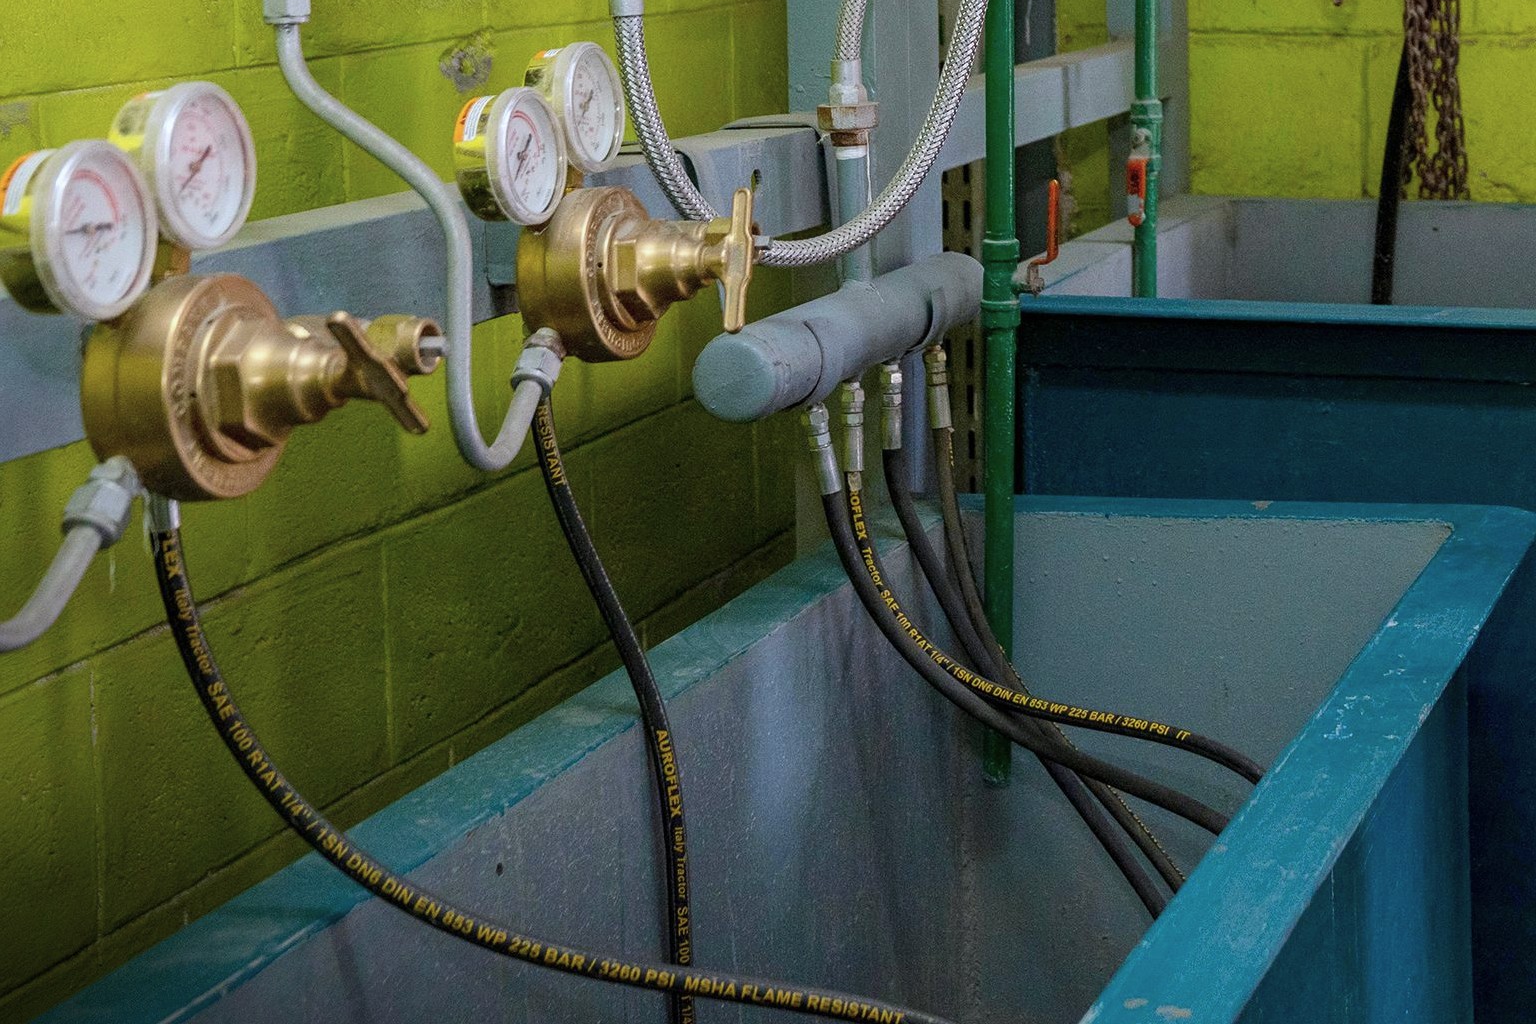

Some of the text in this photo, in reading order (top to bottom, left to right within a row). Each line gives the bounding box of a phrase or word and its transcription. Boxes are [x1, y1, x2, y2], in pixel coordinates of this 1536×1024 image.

[538, 405, 567, 486] RESISTANT
[862, 547, 884, 586] Tractor
[881, 589, 899, 612] SAE
[908, 628, 932, 652] R1AT
[953, 666, 973, 683] 1SN
[971, 678, 994, 692] DN6
[993, 687, 1013, 701] DIN
[1012, 693, 1030, 706] EN
[1029, 698, 1049, 710] 853
[1050, 702, 1068, 714] WP
[1068, 707, 1088, 718] 225
[1089, 711, 1114, 724] BAR
[1121, 716, 1148, 730] 3260
[1149, 722, 1170, 736] PSI
[1176, 729, 1191, 741] IT
[162, 532, 182, 579] LEX
[174, 589, 192, 621] Italy
[185, 625, 214, 675] Tractor
[207, 681, 236, 721] SAE
[229, 720, 253, 751] 100
[248, 750, 285, 791] R1AT
[316, 827, 350, 859] 1SN
[345, 852, 383, 885] DN6
[381, 877, 414, 905] DIN
[413, 895, 442, 920] EN
[476, 925, 507, 945] WP
[544, 947, 585, 970] BAR
[599, 960, 640, 982] 3260
[644, 968, 676, 988] PSI
[684, 976, 737, 998] MSHA
[740, 984, 803, 1008] FLAME
[806, 994, 905, 1024] RESISTANT
[656, 729, 690, 964] AUROFLEX Italy Tractor SAE 100
